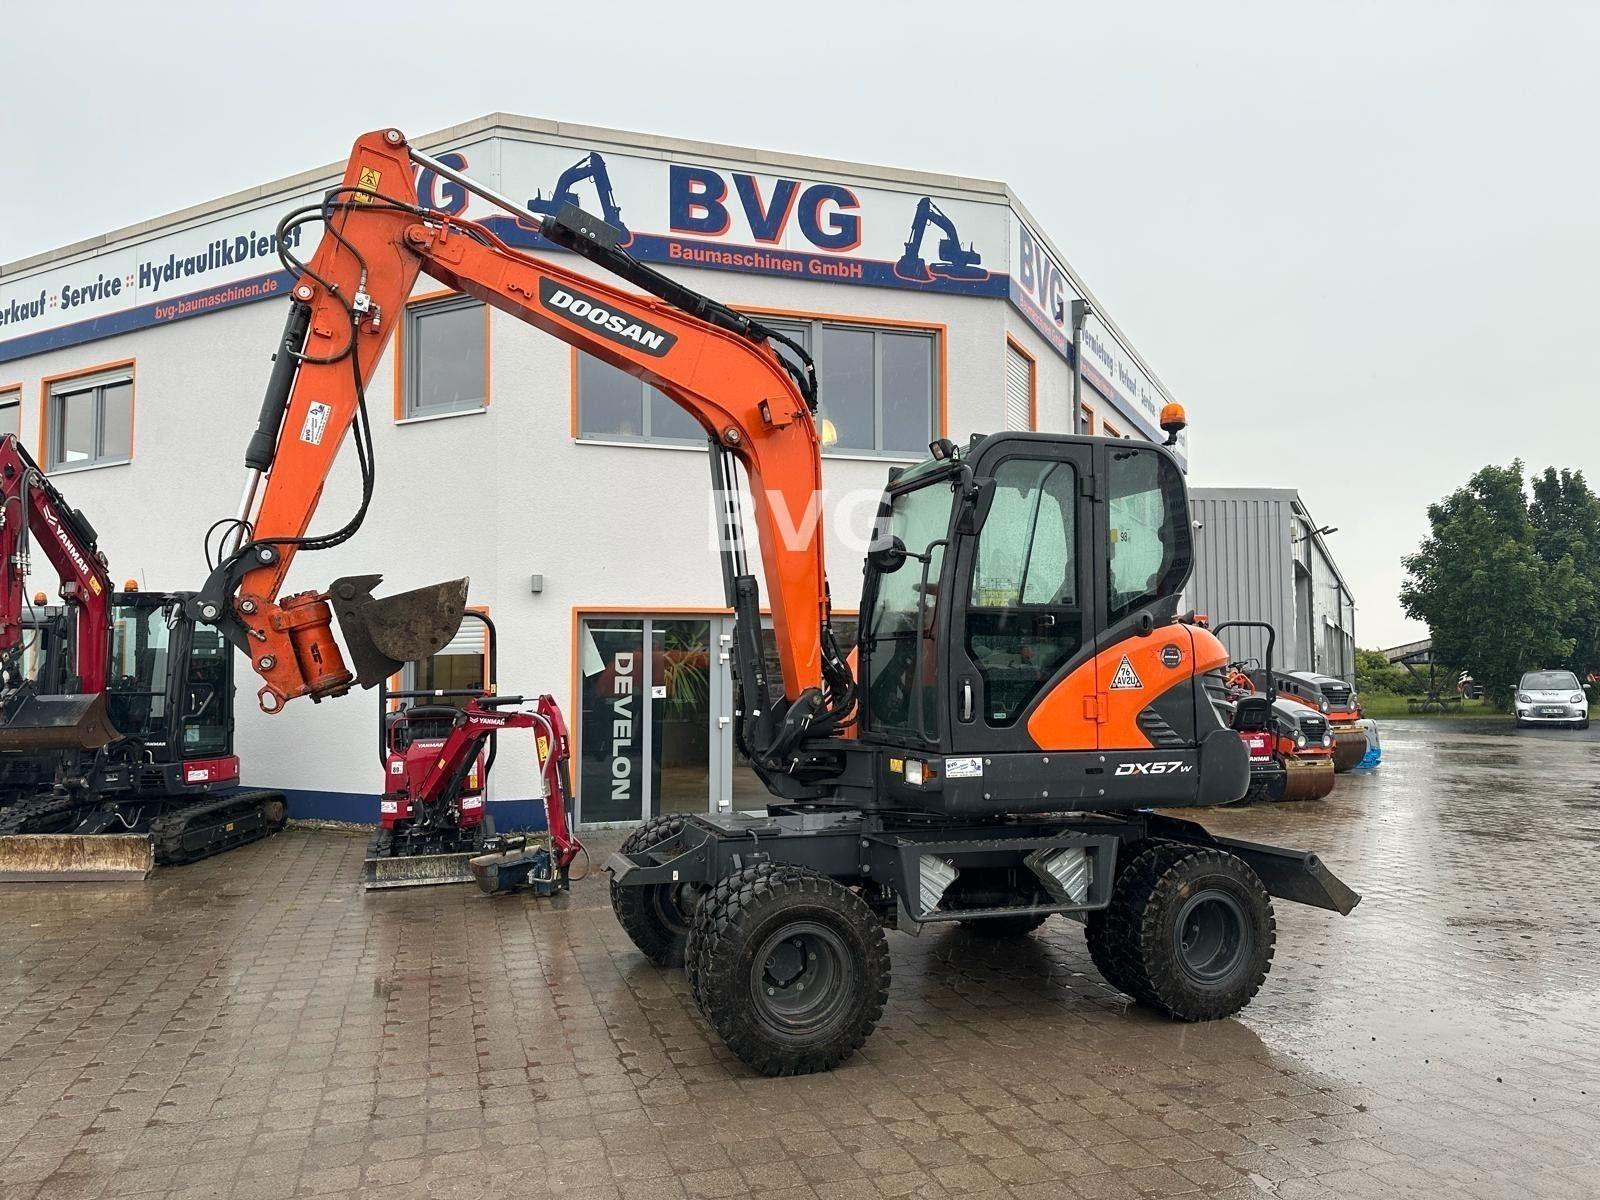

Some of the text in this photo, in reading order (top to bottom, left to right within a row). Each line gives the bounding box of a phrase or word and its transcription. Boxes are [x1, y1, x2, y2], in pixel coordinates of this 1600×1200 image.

[670, 165, 862, 252] BVG
[669, 243, 865, 279] Baumaschinen GmbH
[1020, 223, 1065, 328] BVG
[61, 274, 121, 310] Service
[155, 279, 278, 320] bvg-baumaschinen.de
[548, 290, 664, 350] DOOSAN
[56, 524, 89, 575] YANMAR
[1121, 667, 1131, 677] 76
[611, 652, 634, 801] DEVELON
